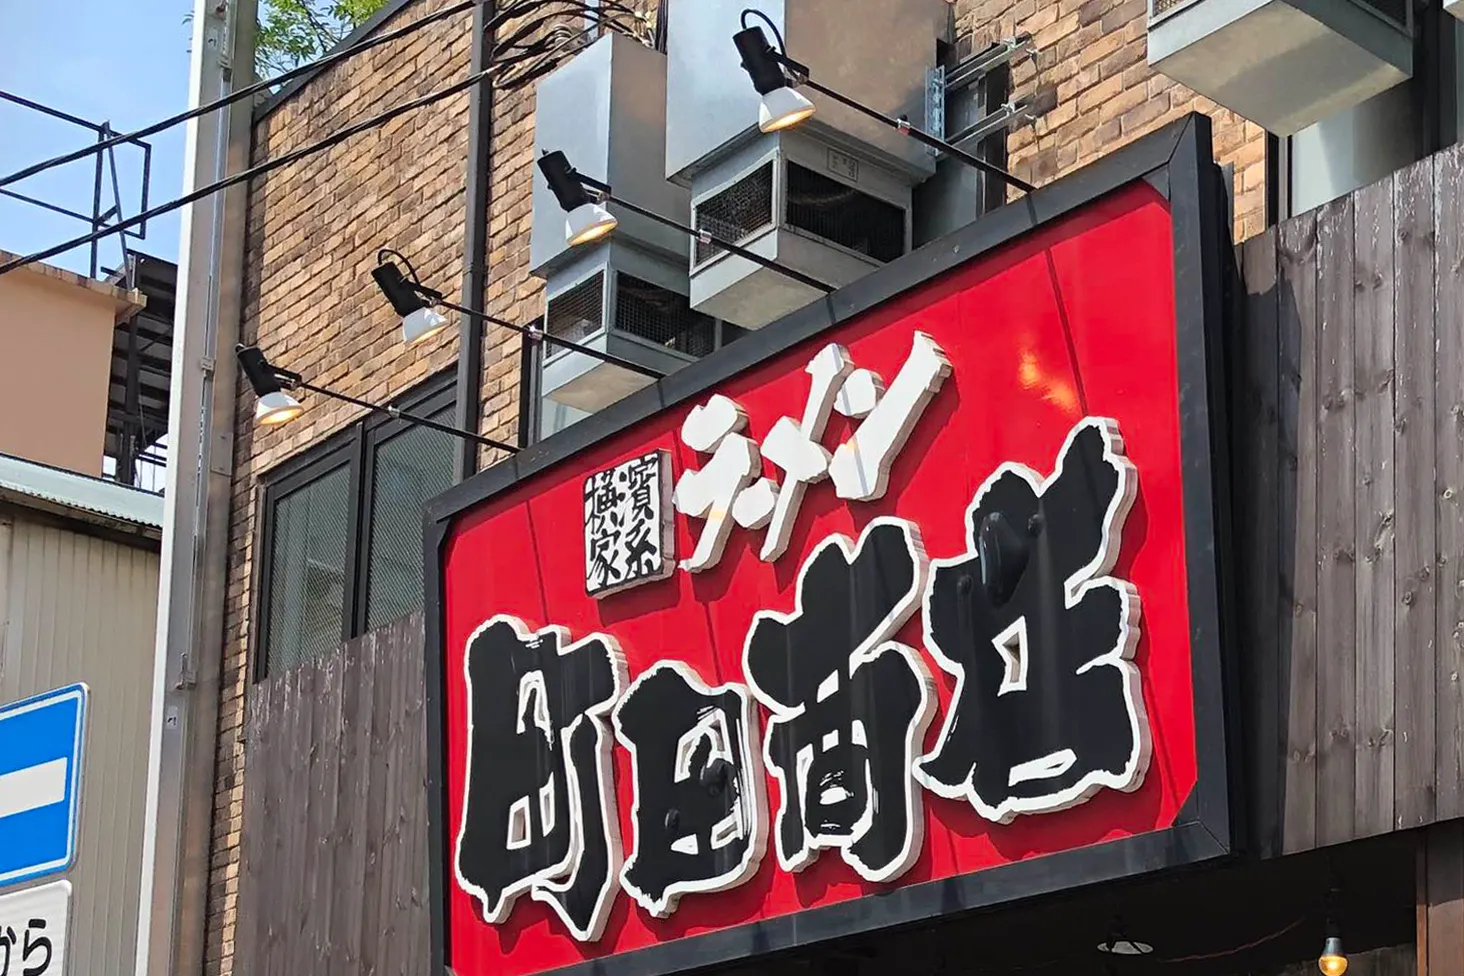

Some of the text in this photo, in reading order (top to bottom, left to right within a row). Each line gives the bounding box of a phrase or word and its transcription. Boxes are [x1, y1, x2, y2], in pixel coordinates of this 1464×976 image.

[676, 330, 951, 572] ラーメン
[454, 416, 1153, 942] 町田商店
